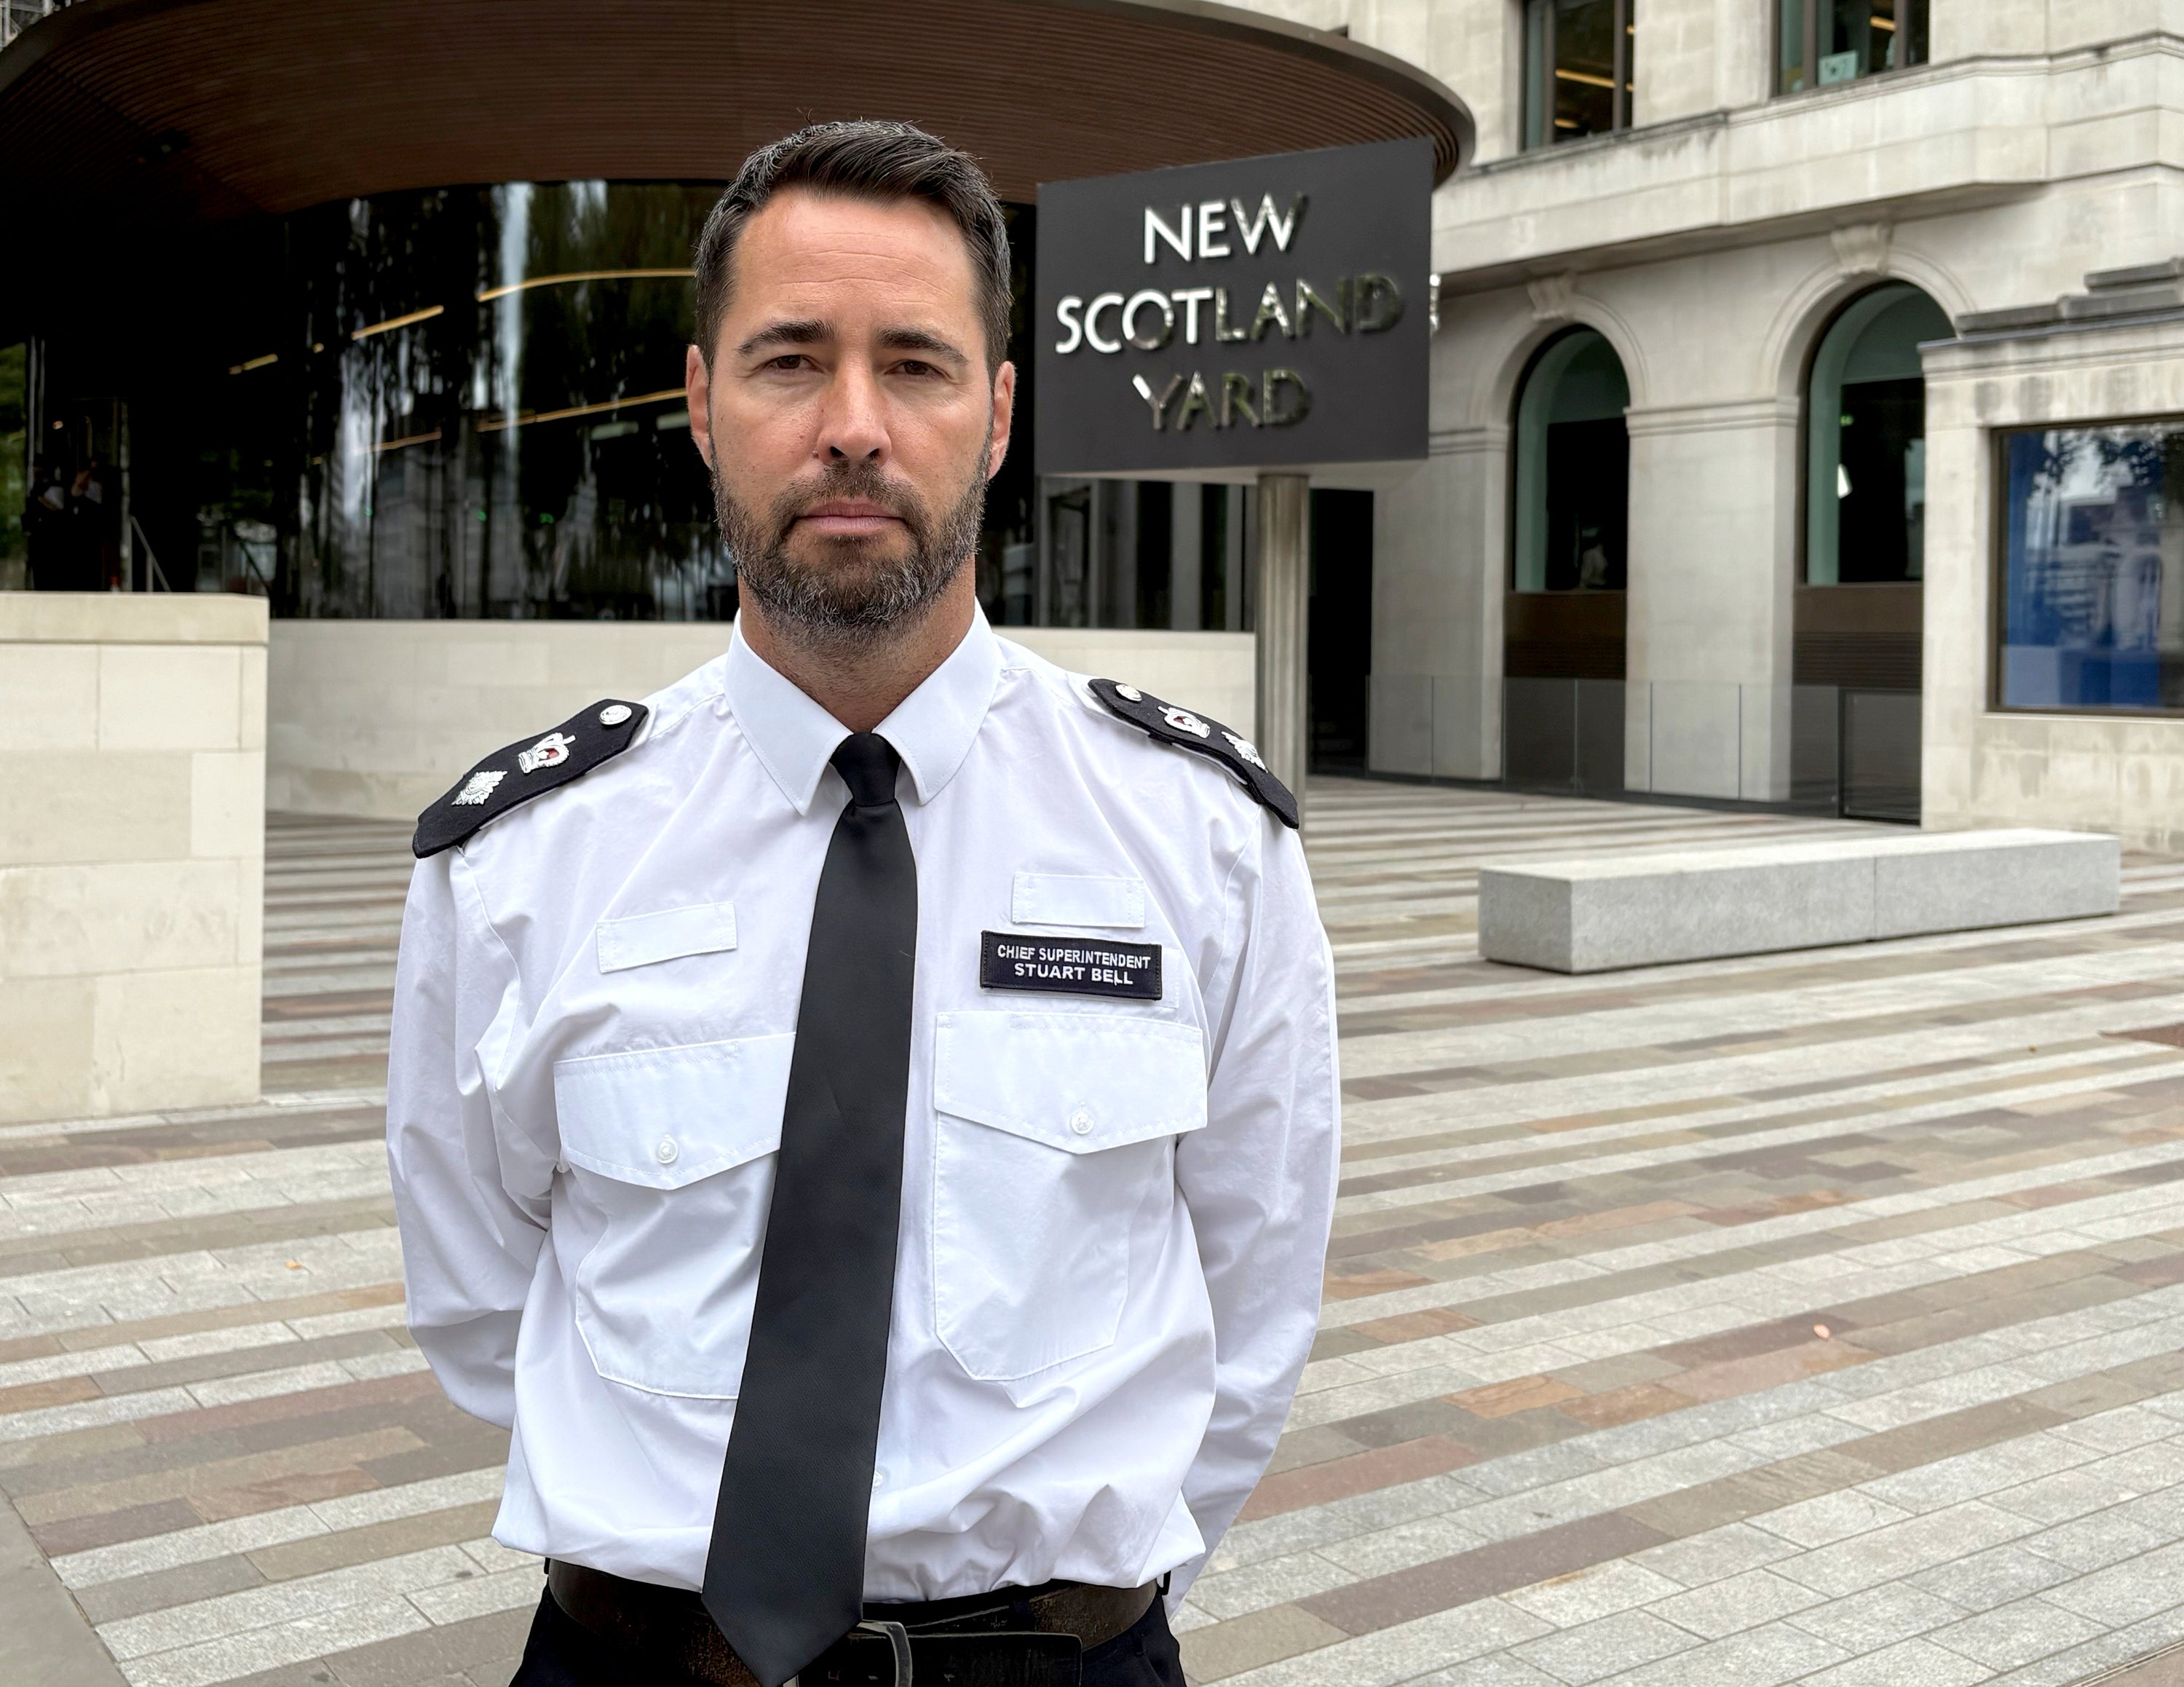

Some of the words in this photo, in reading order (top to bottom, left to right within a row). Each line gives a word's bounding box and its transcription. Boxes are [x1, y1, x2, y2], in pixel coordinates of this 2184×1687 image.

[1144, 191, 1308, 264] NEW
[1056, 272, 1402, 354] SCOTLAND
[1131, 368, 1311, 430] YARD
[997, 944, 1035, 960] CHIEF
[1039, 948, 1151, 969] SUPERINTENDENT
[1014, 963, 1085, 980] STUART
[1091, 968, 1133, 986] BELL
